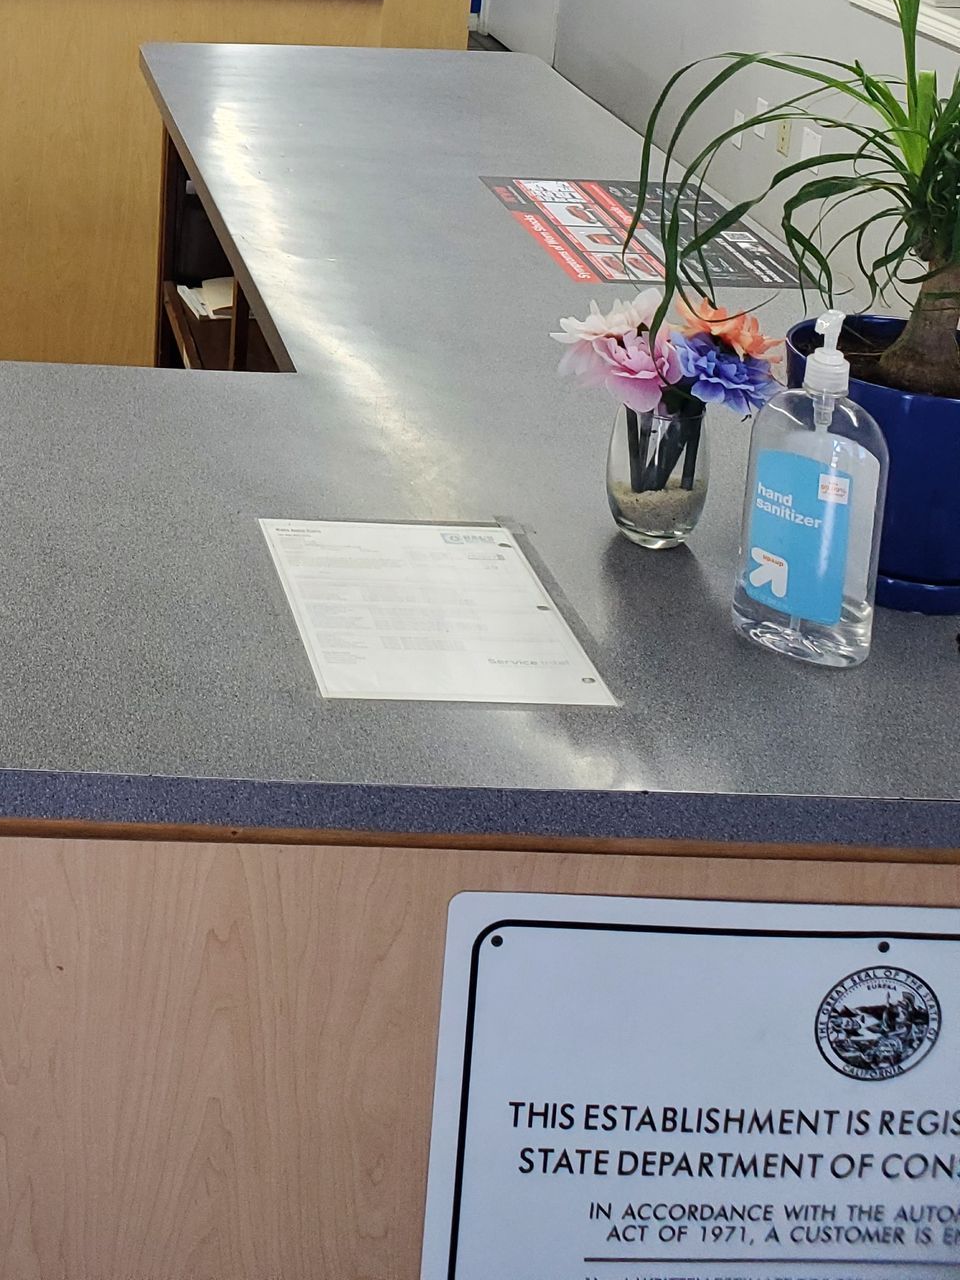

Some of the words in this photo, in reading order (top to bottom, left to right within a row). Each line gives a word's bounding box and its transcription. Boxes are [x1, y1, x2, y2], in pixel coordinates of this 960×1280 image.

[757, 481, 792, 507] hand
[756, 497, 822, 529] sanitizer
[488, 657, 538, 667] Service
[842, 1064, 904, 1079] CALIFORNIA
[509, 1101, 575, 1129] THIS
[584, 1104, 840, 1136] ESTABLISHMENT
[846, 1109, 871, 1136] IS
[518, 1147, 609, 1175] STATE
[617, 1150, 824, 1178] DEPARTMENT
[830, 1153, 874, 1179] OF
[881, 1153, 960, 1180] CON
[589, 1202, 612, 1220] IN
[621, 1203, 773, 1221] ACCORDANCE
[784, 1204, 836, 1222] WITH
[847, 1205, 885, 1222] THE
[606, 1225, 648, 1242] ACT
[658, 1225, 688, 1242] OF
[700, 1225, 754, 1246] 1971,
[764, 1226, 780, 1243] A
[790, 1226, 904, 1245] CUSTOMER
[915, 1227, 932, 1245] IS
